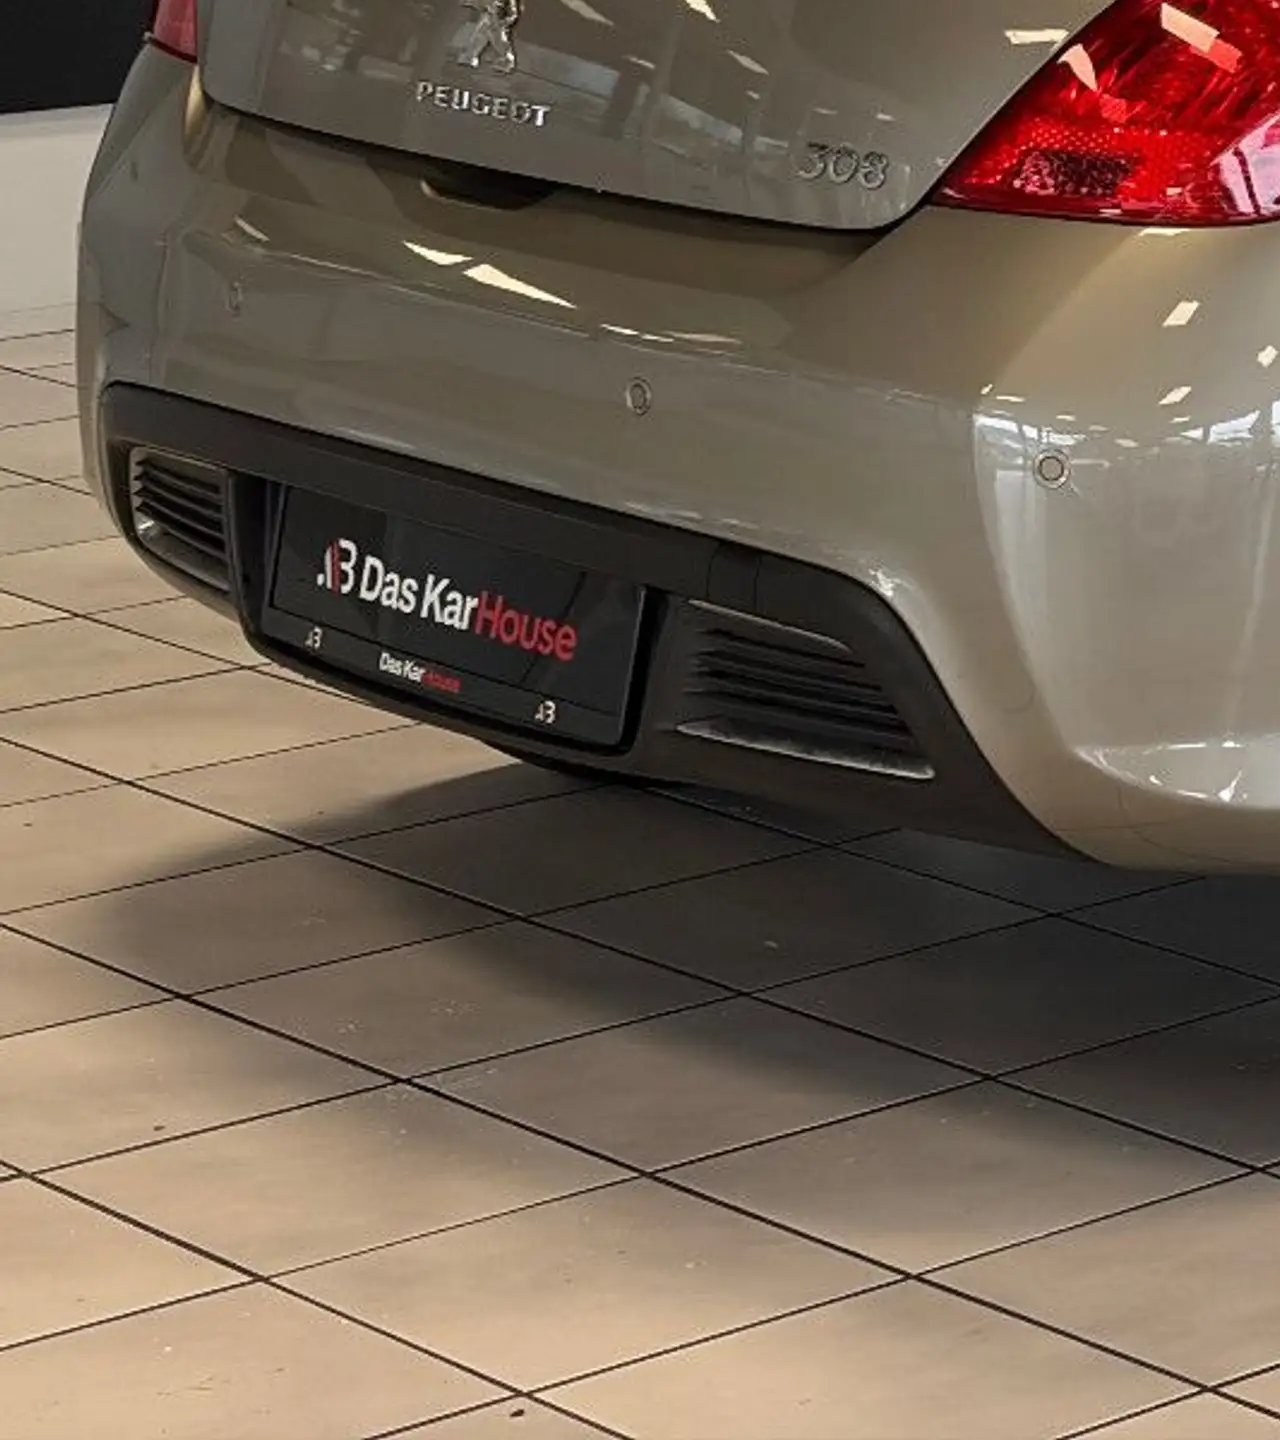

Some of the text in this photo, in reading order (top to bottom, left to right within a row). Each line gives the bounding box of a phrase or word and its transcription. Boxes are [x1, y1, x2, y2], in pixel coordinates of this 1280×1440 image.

[416, 80, 551, 127] PEUGEOT
[796, 141, 889, 190] 308
[359, 555, 419, 613] Das
